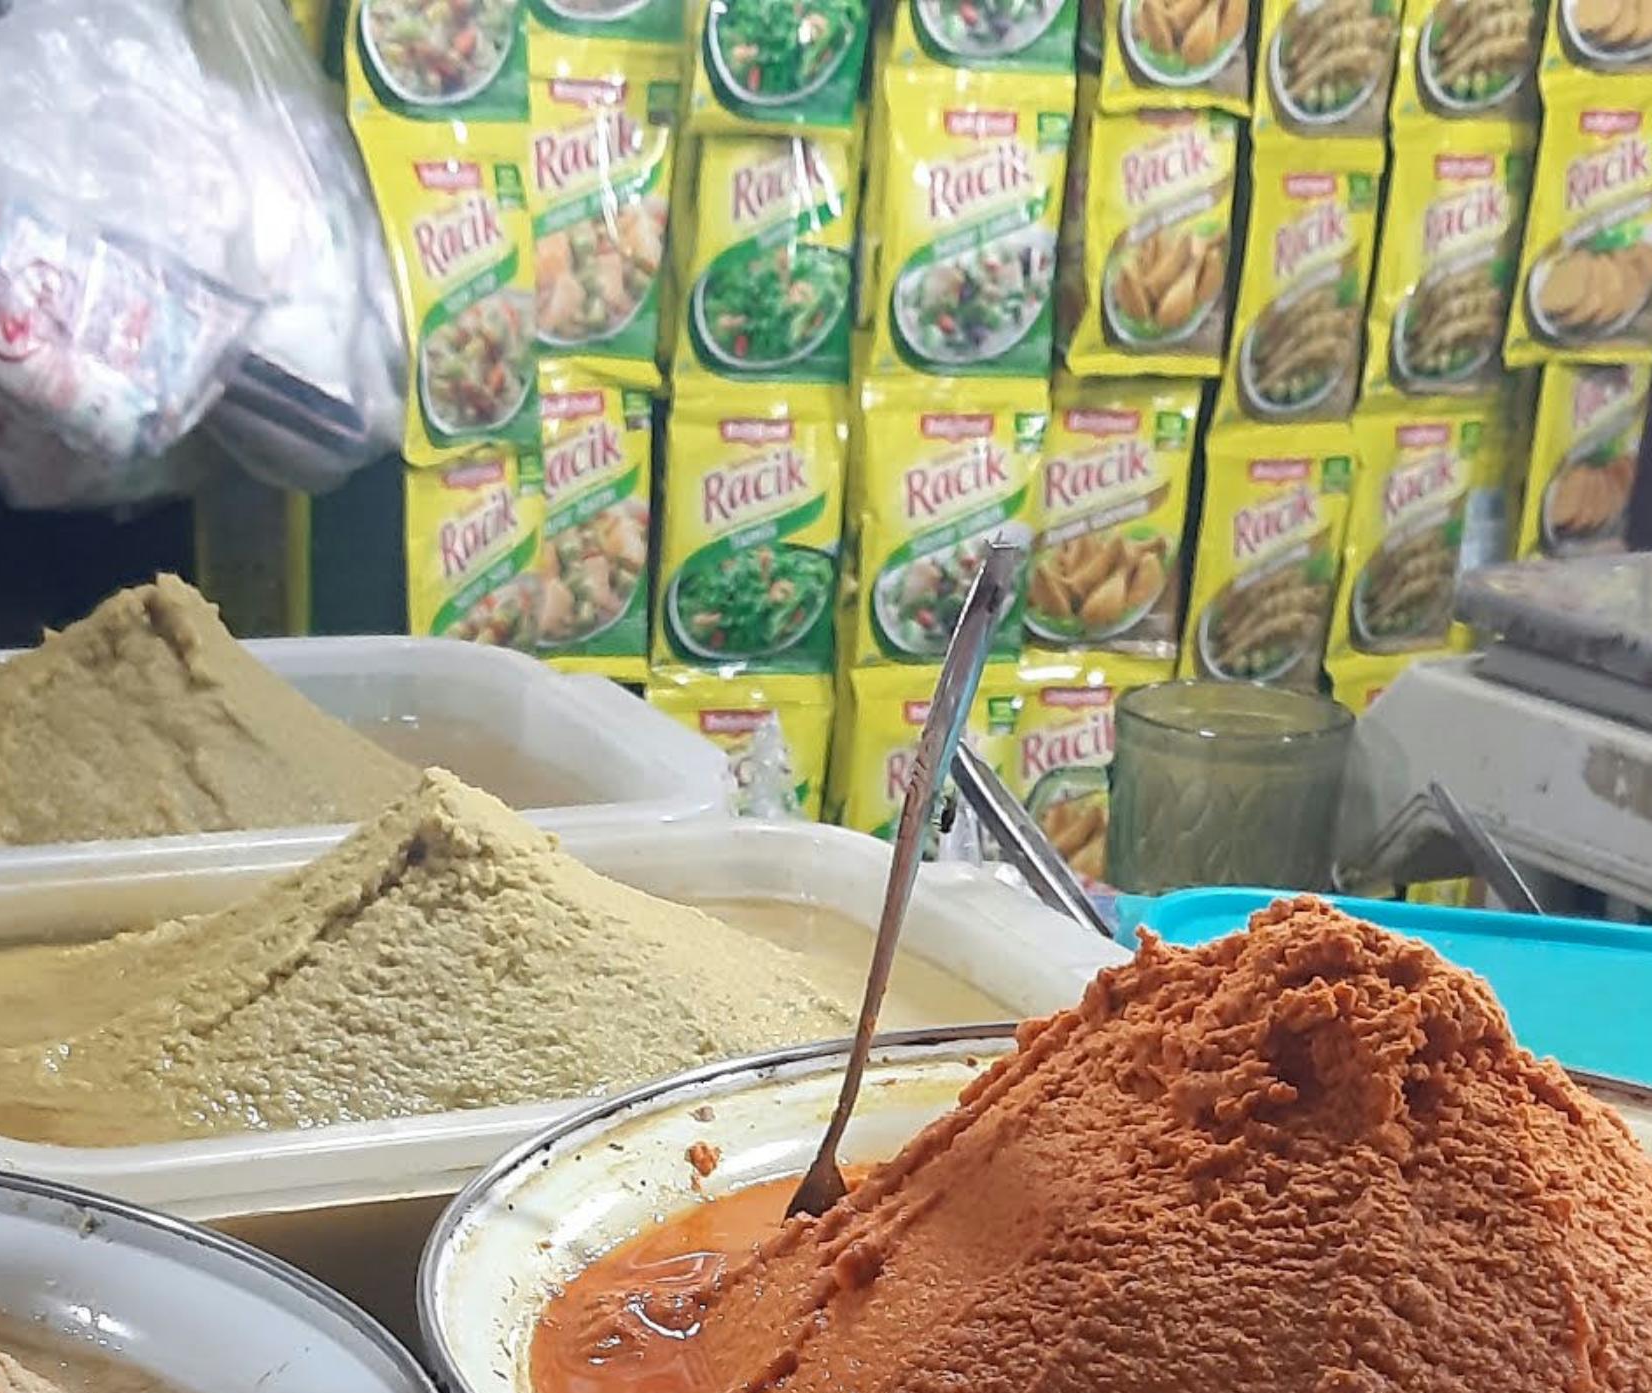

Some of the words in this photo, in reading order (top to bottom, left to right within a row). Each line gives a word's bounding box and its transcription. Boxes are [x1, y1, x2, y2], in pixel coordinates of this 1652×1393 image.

[930, 141, 1034, 217] Racik
[1123, 131, 1212, 205] Racik
[1566, 139, 1649, 210] Racik
[415, 196, 504, 278] Racik
[543, 422, 622, 499] acik
[702, 450, 808, 523] Racik
[905, 444, 1009, 517] Racik
[1044, 441, 1148, 509] Racik
[440, 488, 519, 578] Racik
[1233, 488, 1318, 559] Racik
